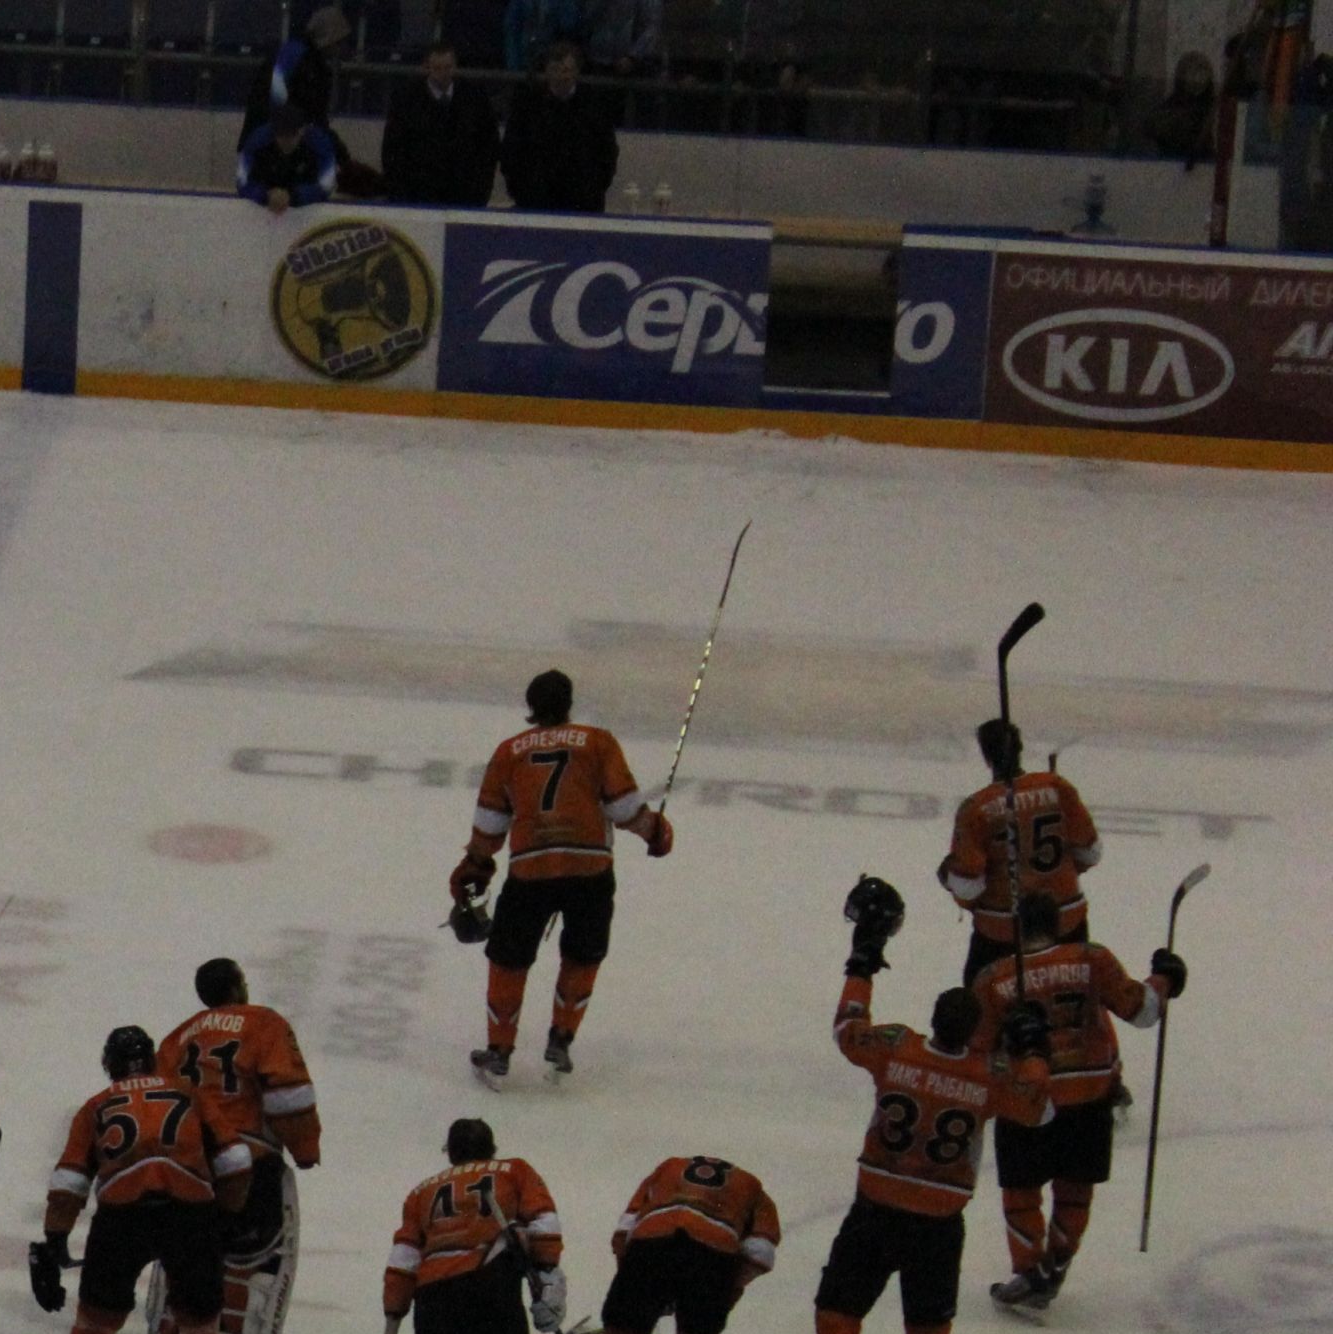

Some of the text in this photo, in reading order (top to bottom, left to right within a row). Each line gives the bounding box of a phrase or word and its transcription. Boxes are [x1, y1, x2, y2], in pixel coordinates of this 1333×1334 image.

[1005, 264, 1333, 307] ОФИЦИАЛЬНЫЙ ДИЛЕ
[1043, 333, 1195, 398] KIA
[531, 749, 572, 812] 7
[95, 1089, 193, 1160] 57
[878, 1092, 977, 1166] 38
